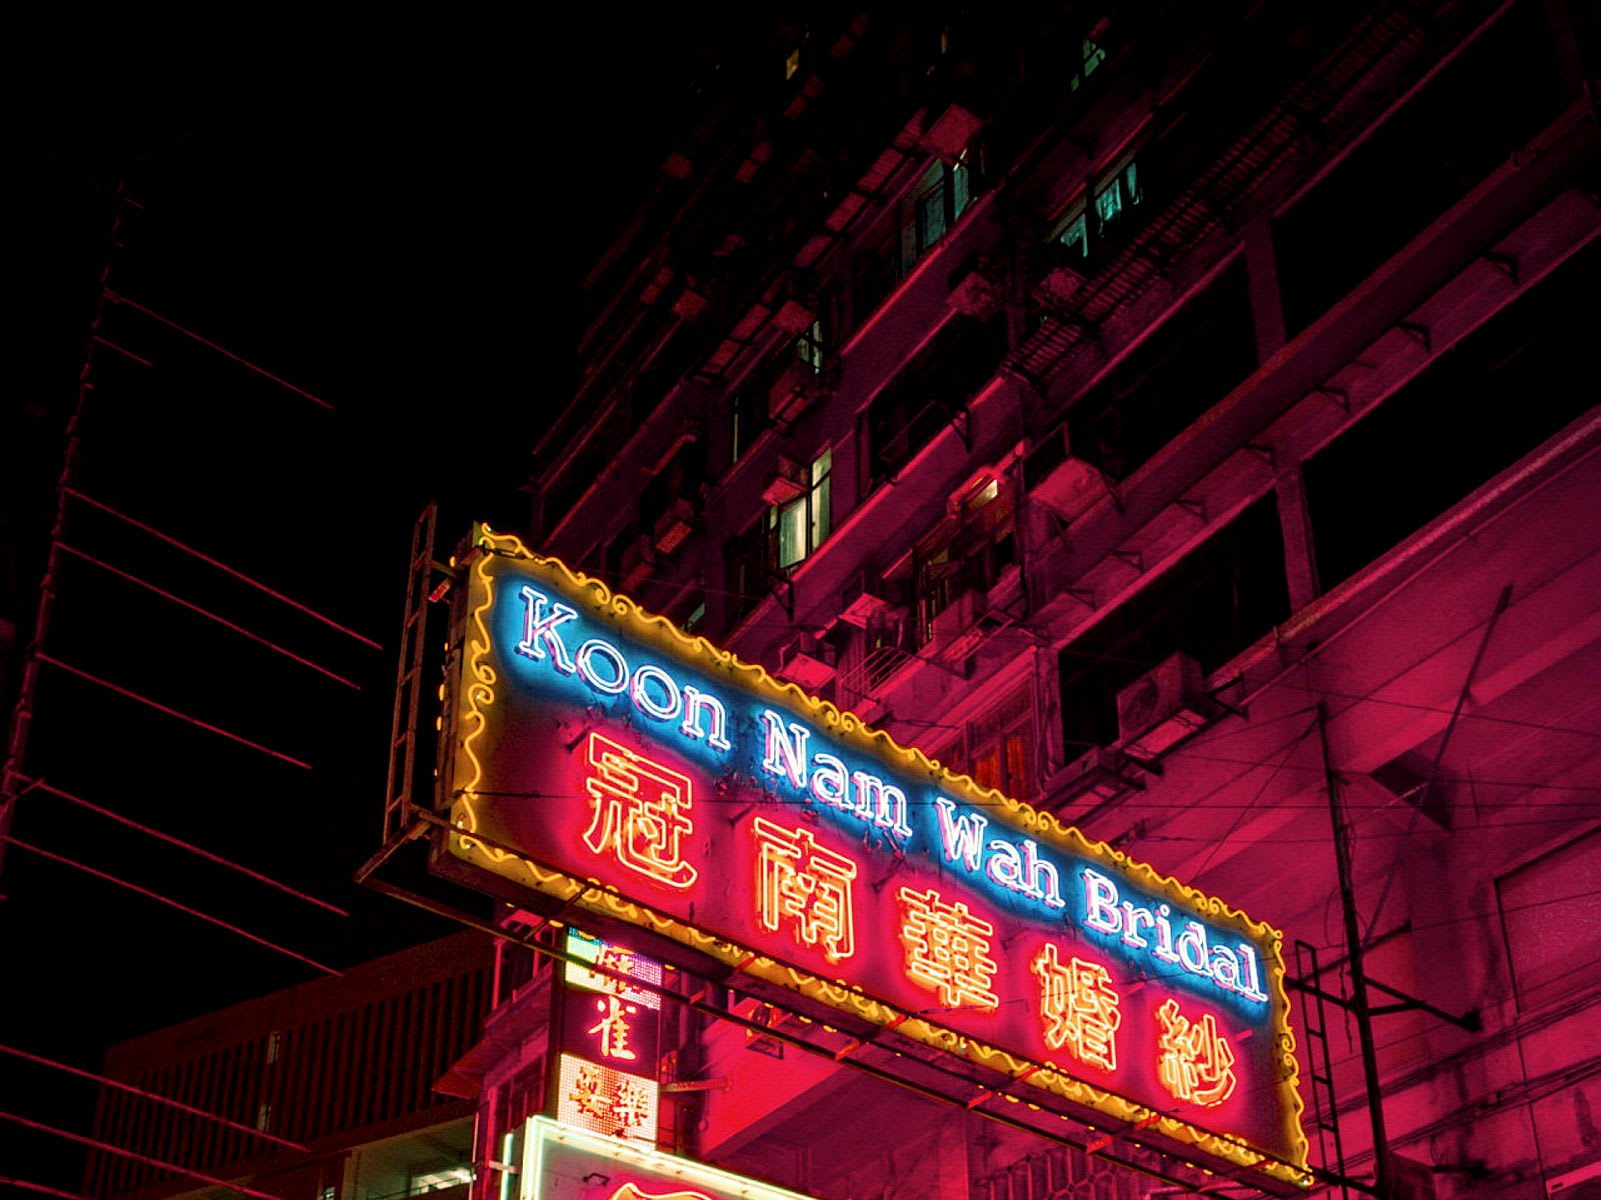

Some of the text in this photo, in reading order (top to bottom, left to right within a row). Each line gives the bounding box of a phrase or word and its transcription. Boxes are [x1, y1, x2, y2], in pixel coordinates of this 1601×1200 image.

[515, 586, 1268, 1003] Koon Nam Wah Bridal
[583, 732, 1237, 1106] 冠南華婚紗
